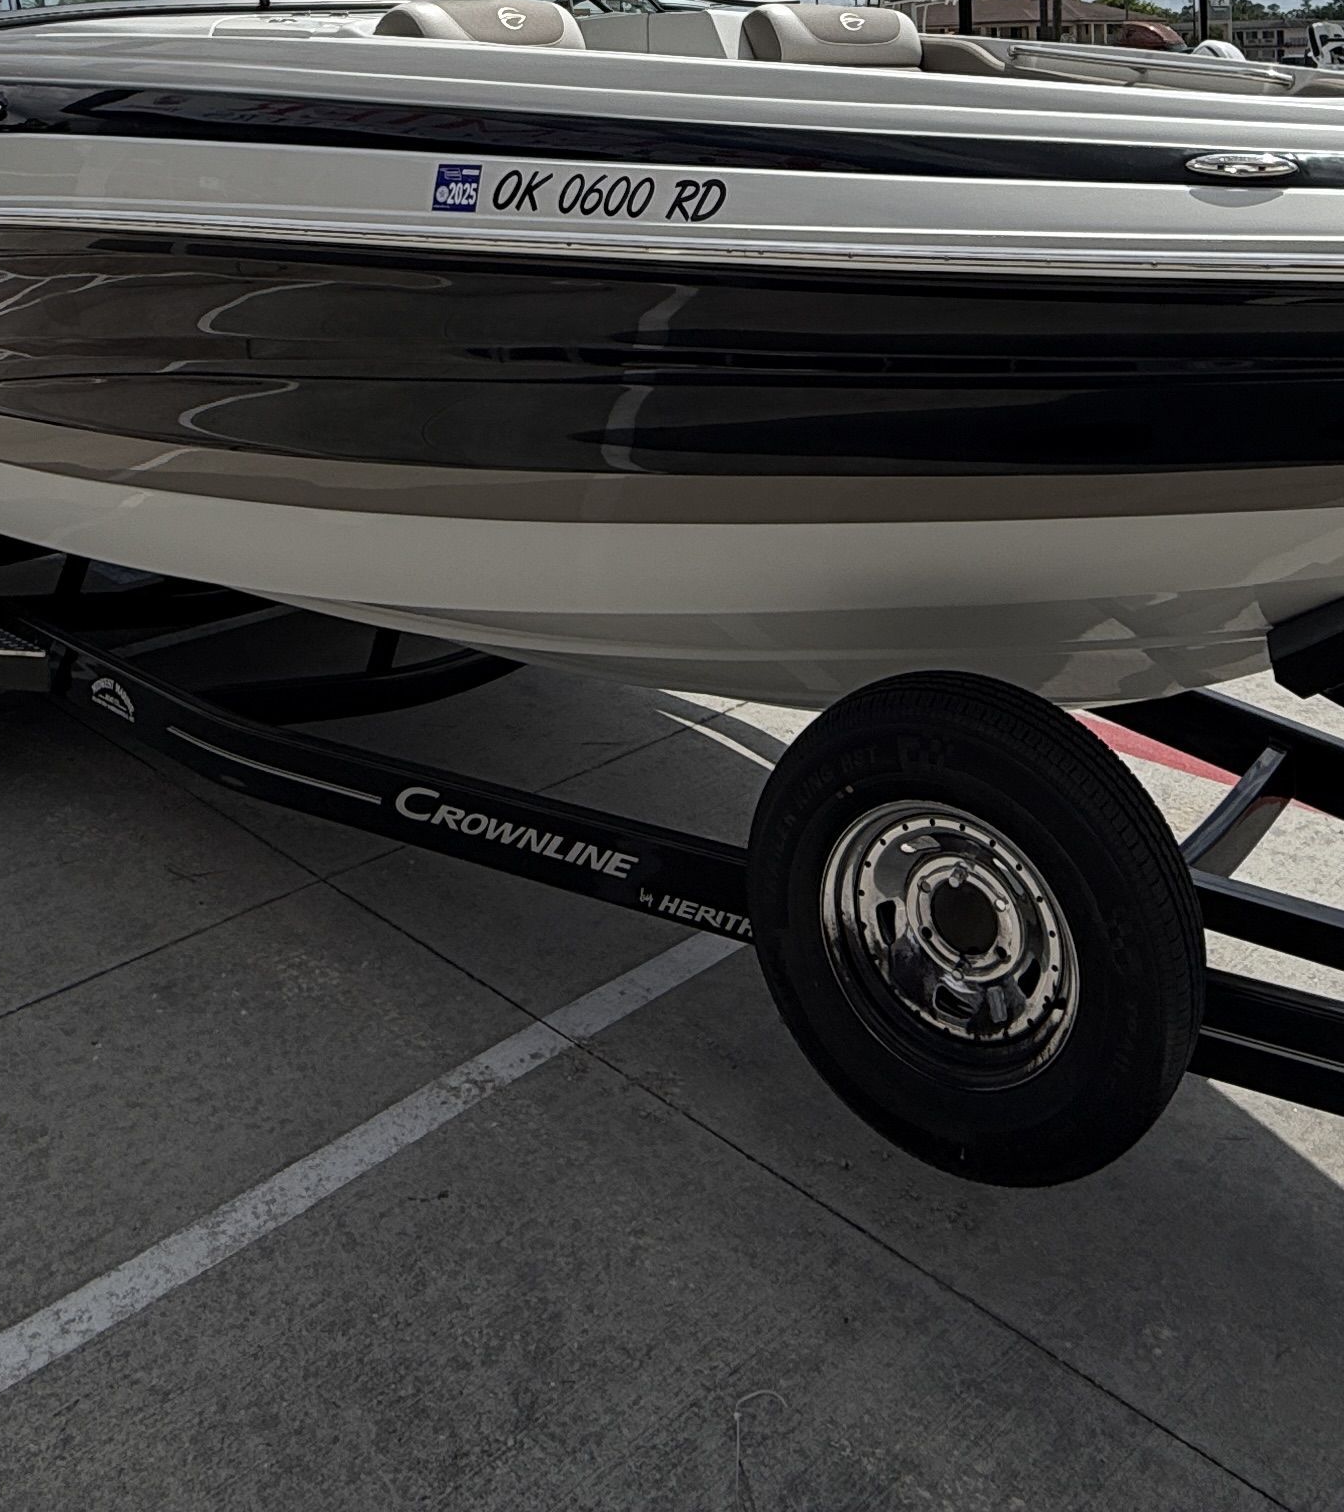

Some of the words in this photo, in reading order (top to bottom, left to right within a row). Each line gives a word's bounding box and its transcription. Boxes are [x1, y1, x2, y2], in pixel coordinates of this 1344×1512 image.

[446, 182, 477, 205] 2025
[492, 169, 554, 212] OK
[558, 173, 655, 218] 0600
[665, 178, 727, 222] RD
[395, 786, 639, 879] CROWNLINE
[639, 887, 654, 908] by
